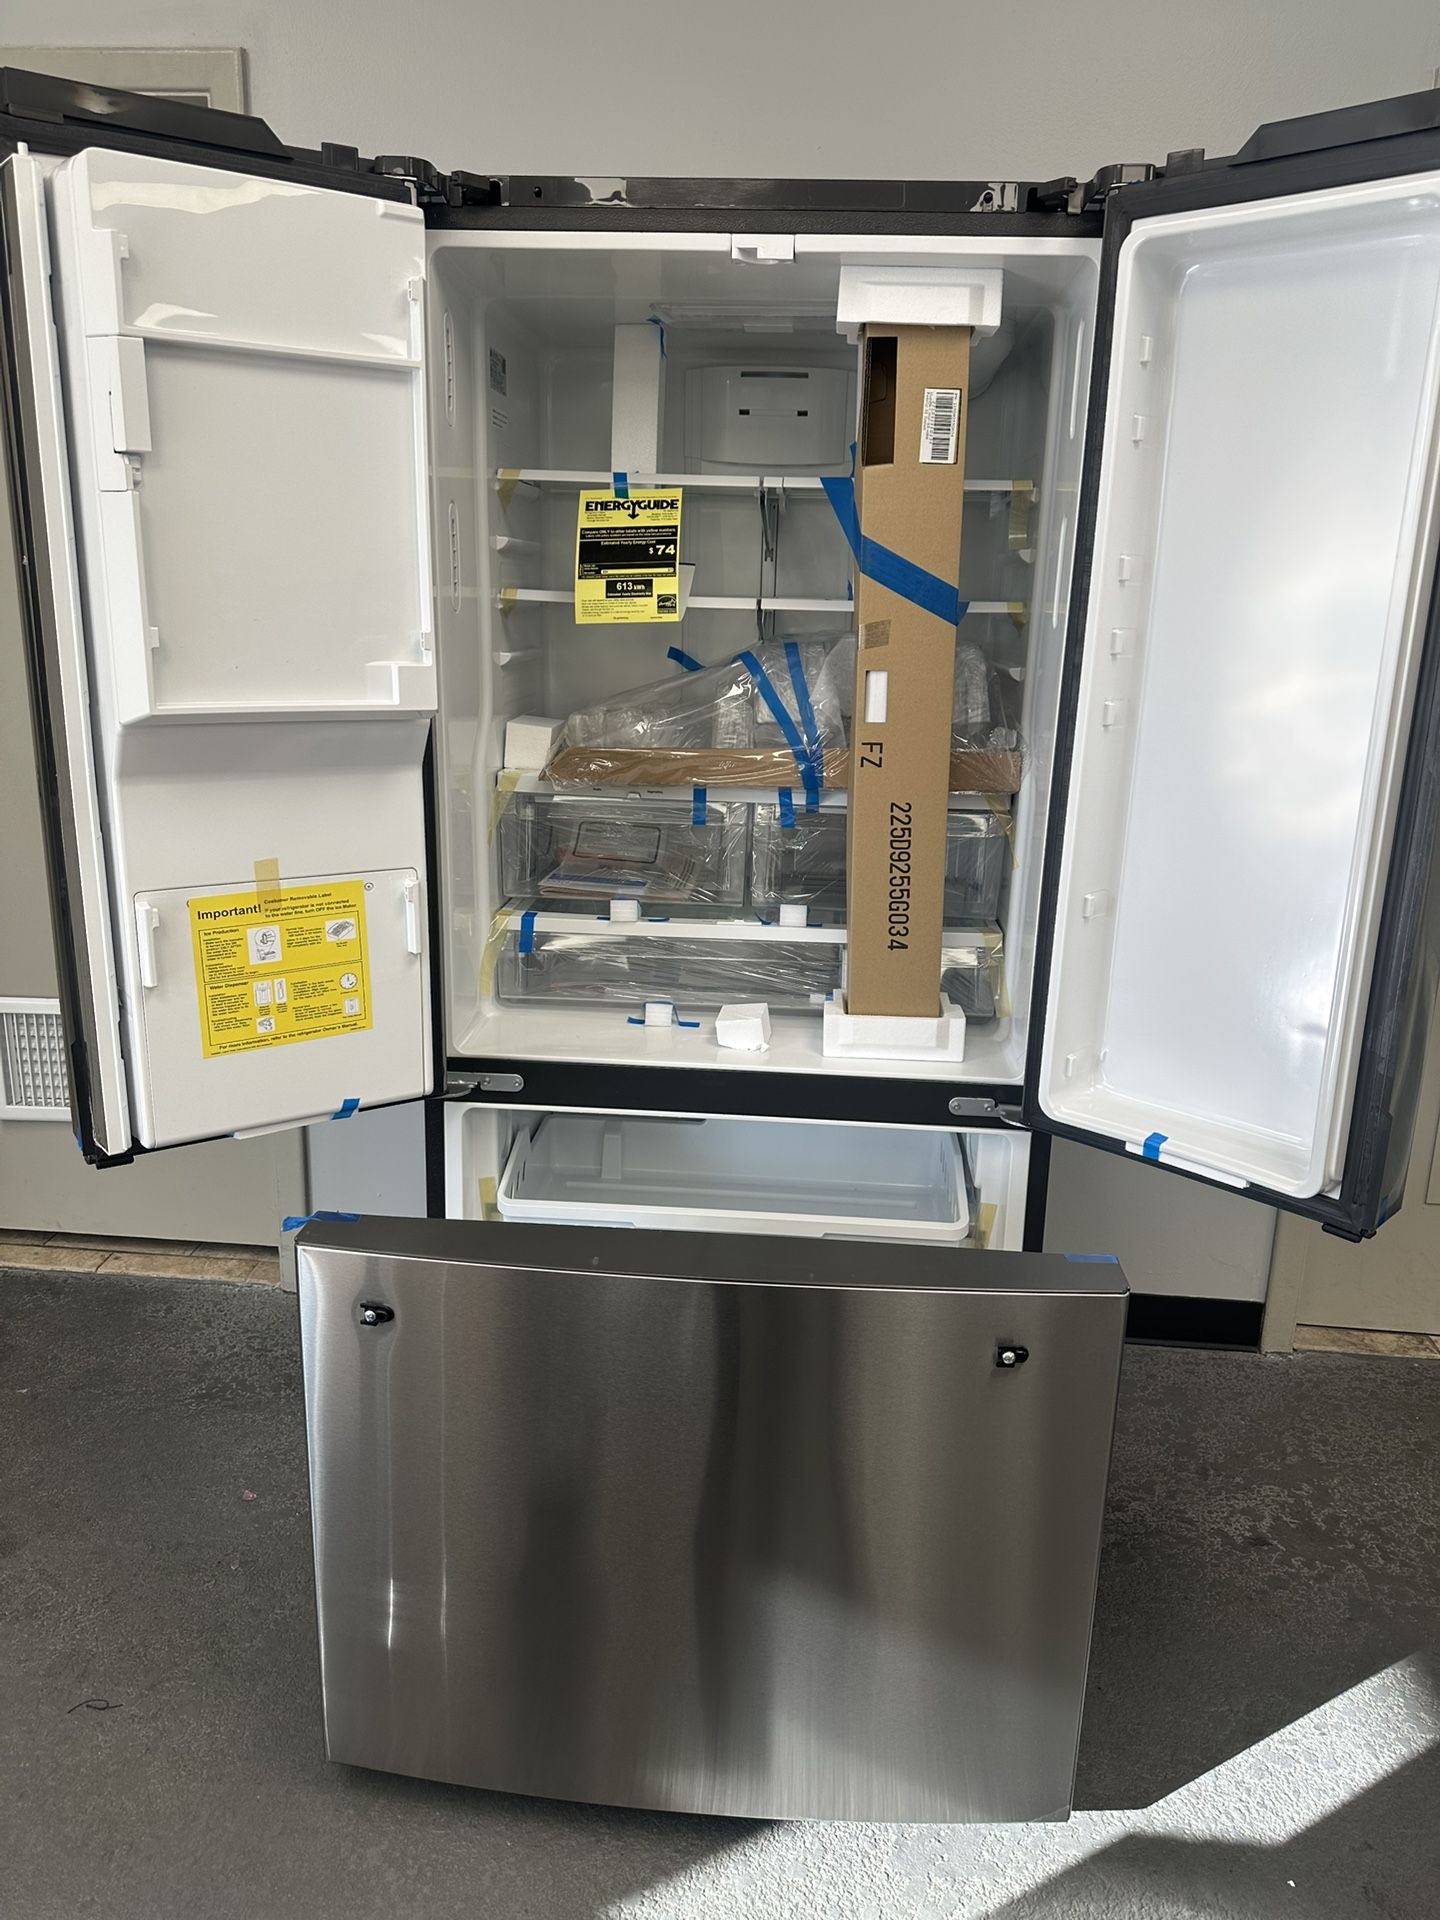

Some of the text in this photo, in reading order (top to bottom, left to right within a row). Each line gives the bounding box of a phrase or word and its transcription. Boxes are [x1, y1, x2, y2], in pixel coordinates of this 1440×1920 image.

[585, 499, 679, 512] ENERGYGUIDE
[656, 544, 675, 555] 74
[616, 582, 633, 591] 613
[860, 741, 883, 768] FZ
[888, 802, 912, 951] 225D9255G034
[197, 904, 261, 920] Important!
